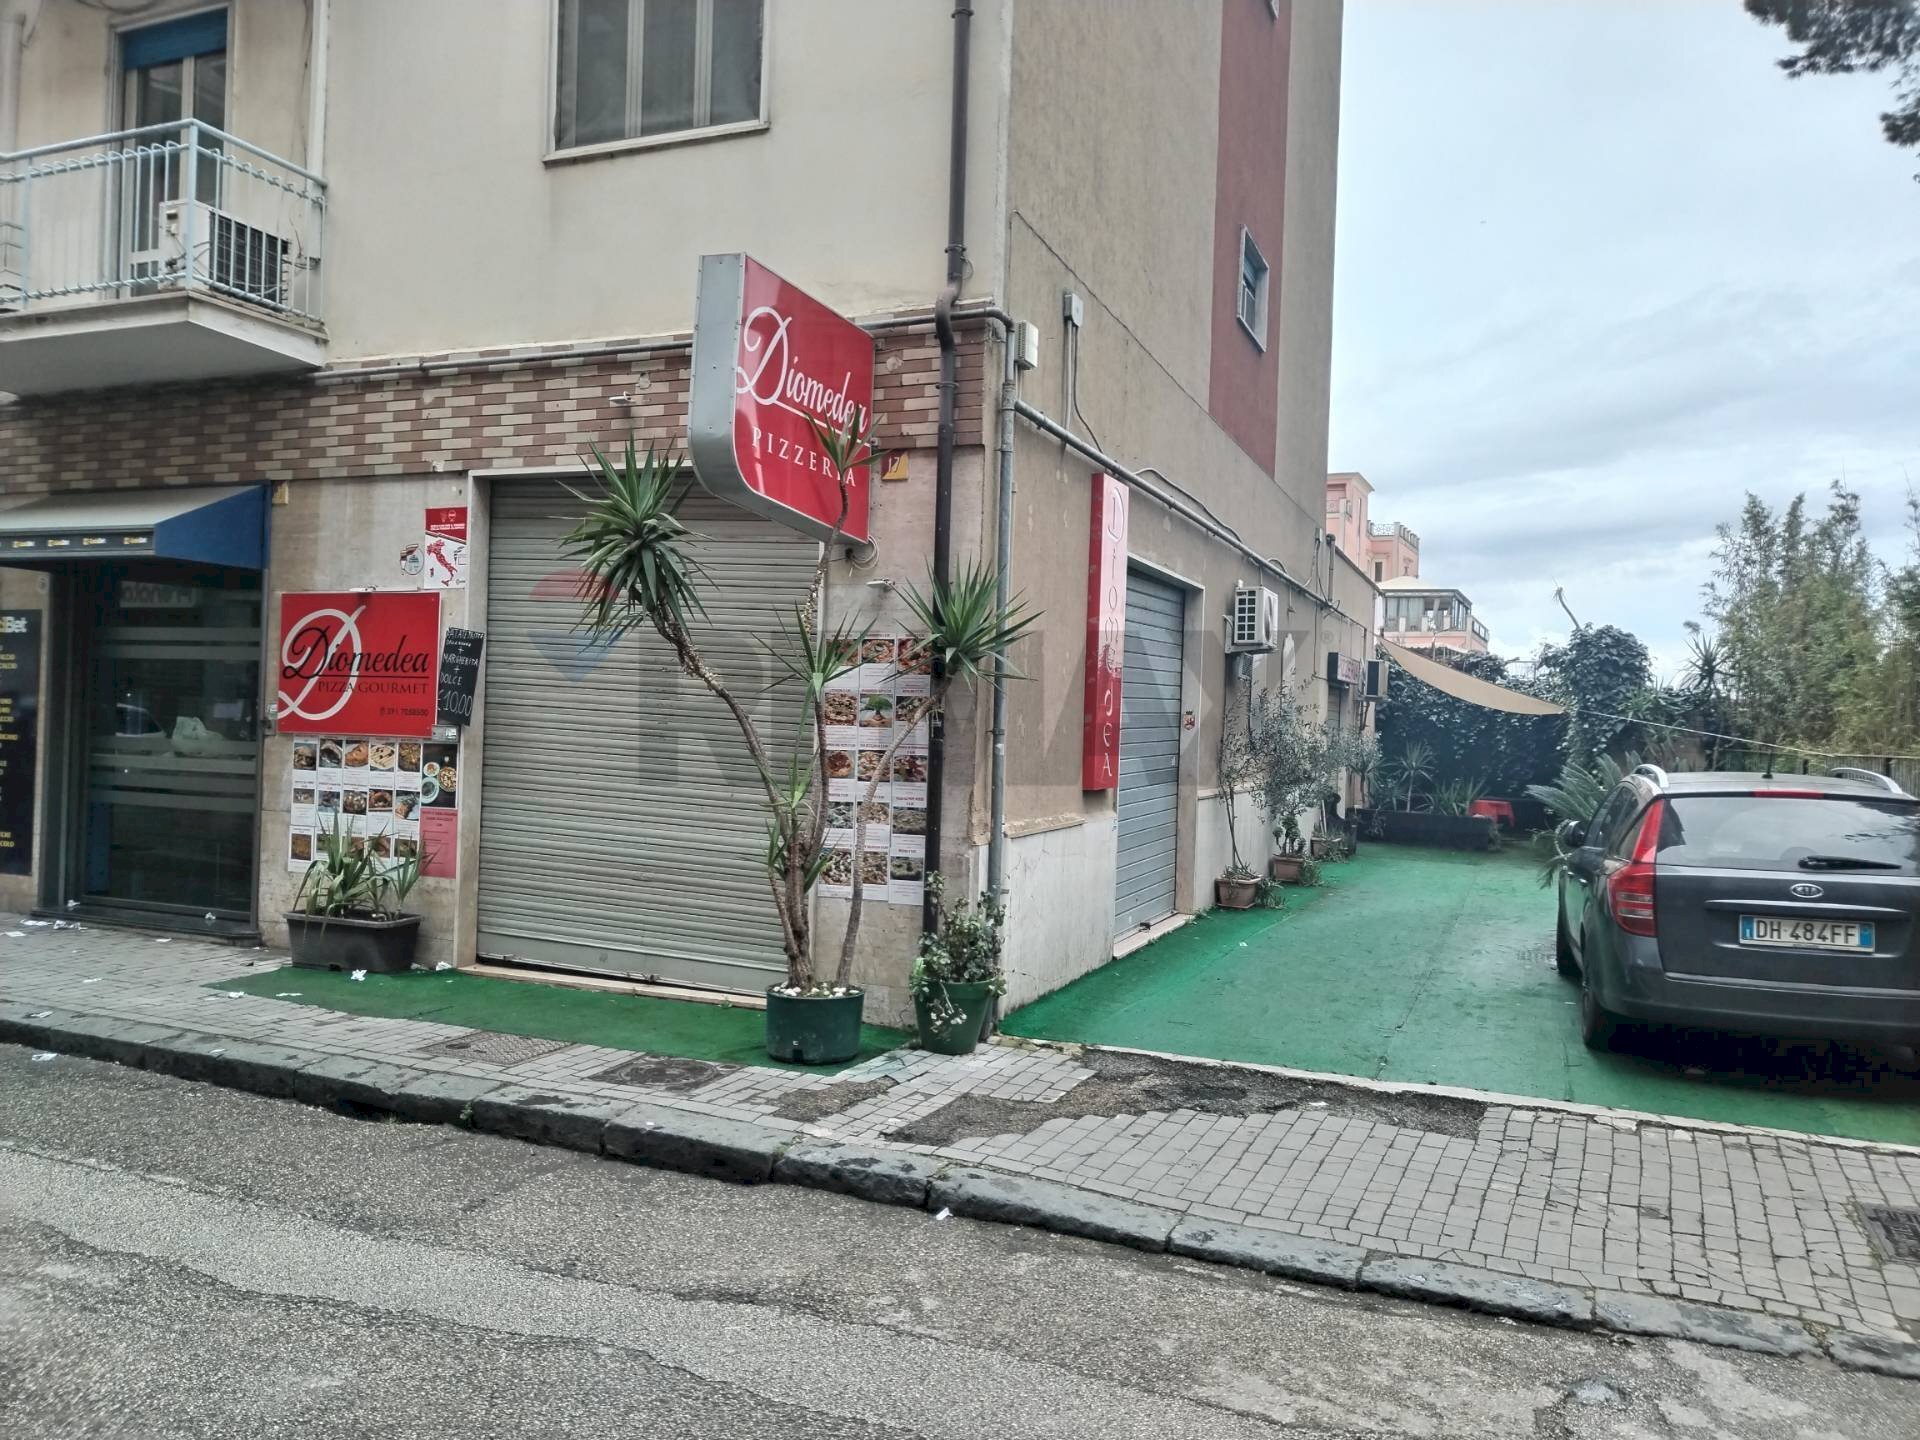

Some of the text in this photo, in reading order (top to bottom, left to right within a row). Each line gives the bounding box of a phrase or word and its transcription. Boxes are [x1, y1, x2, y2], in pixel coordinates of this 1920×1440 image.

[888, 455, 901, 472] 17
[282, 626, 430, 679] Diomedea
[440, 672, 462, 685] DOLCE
[318, 682, 430, 694] PIZZA GOURMET
